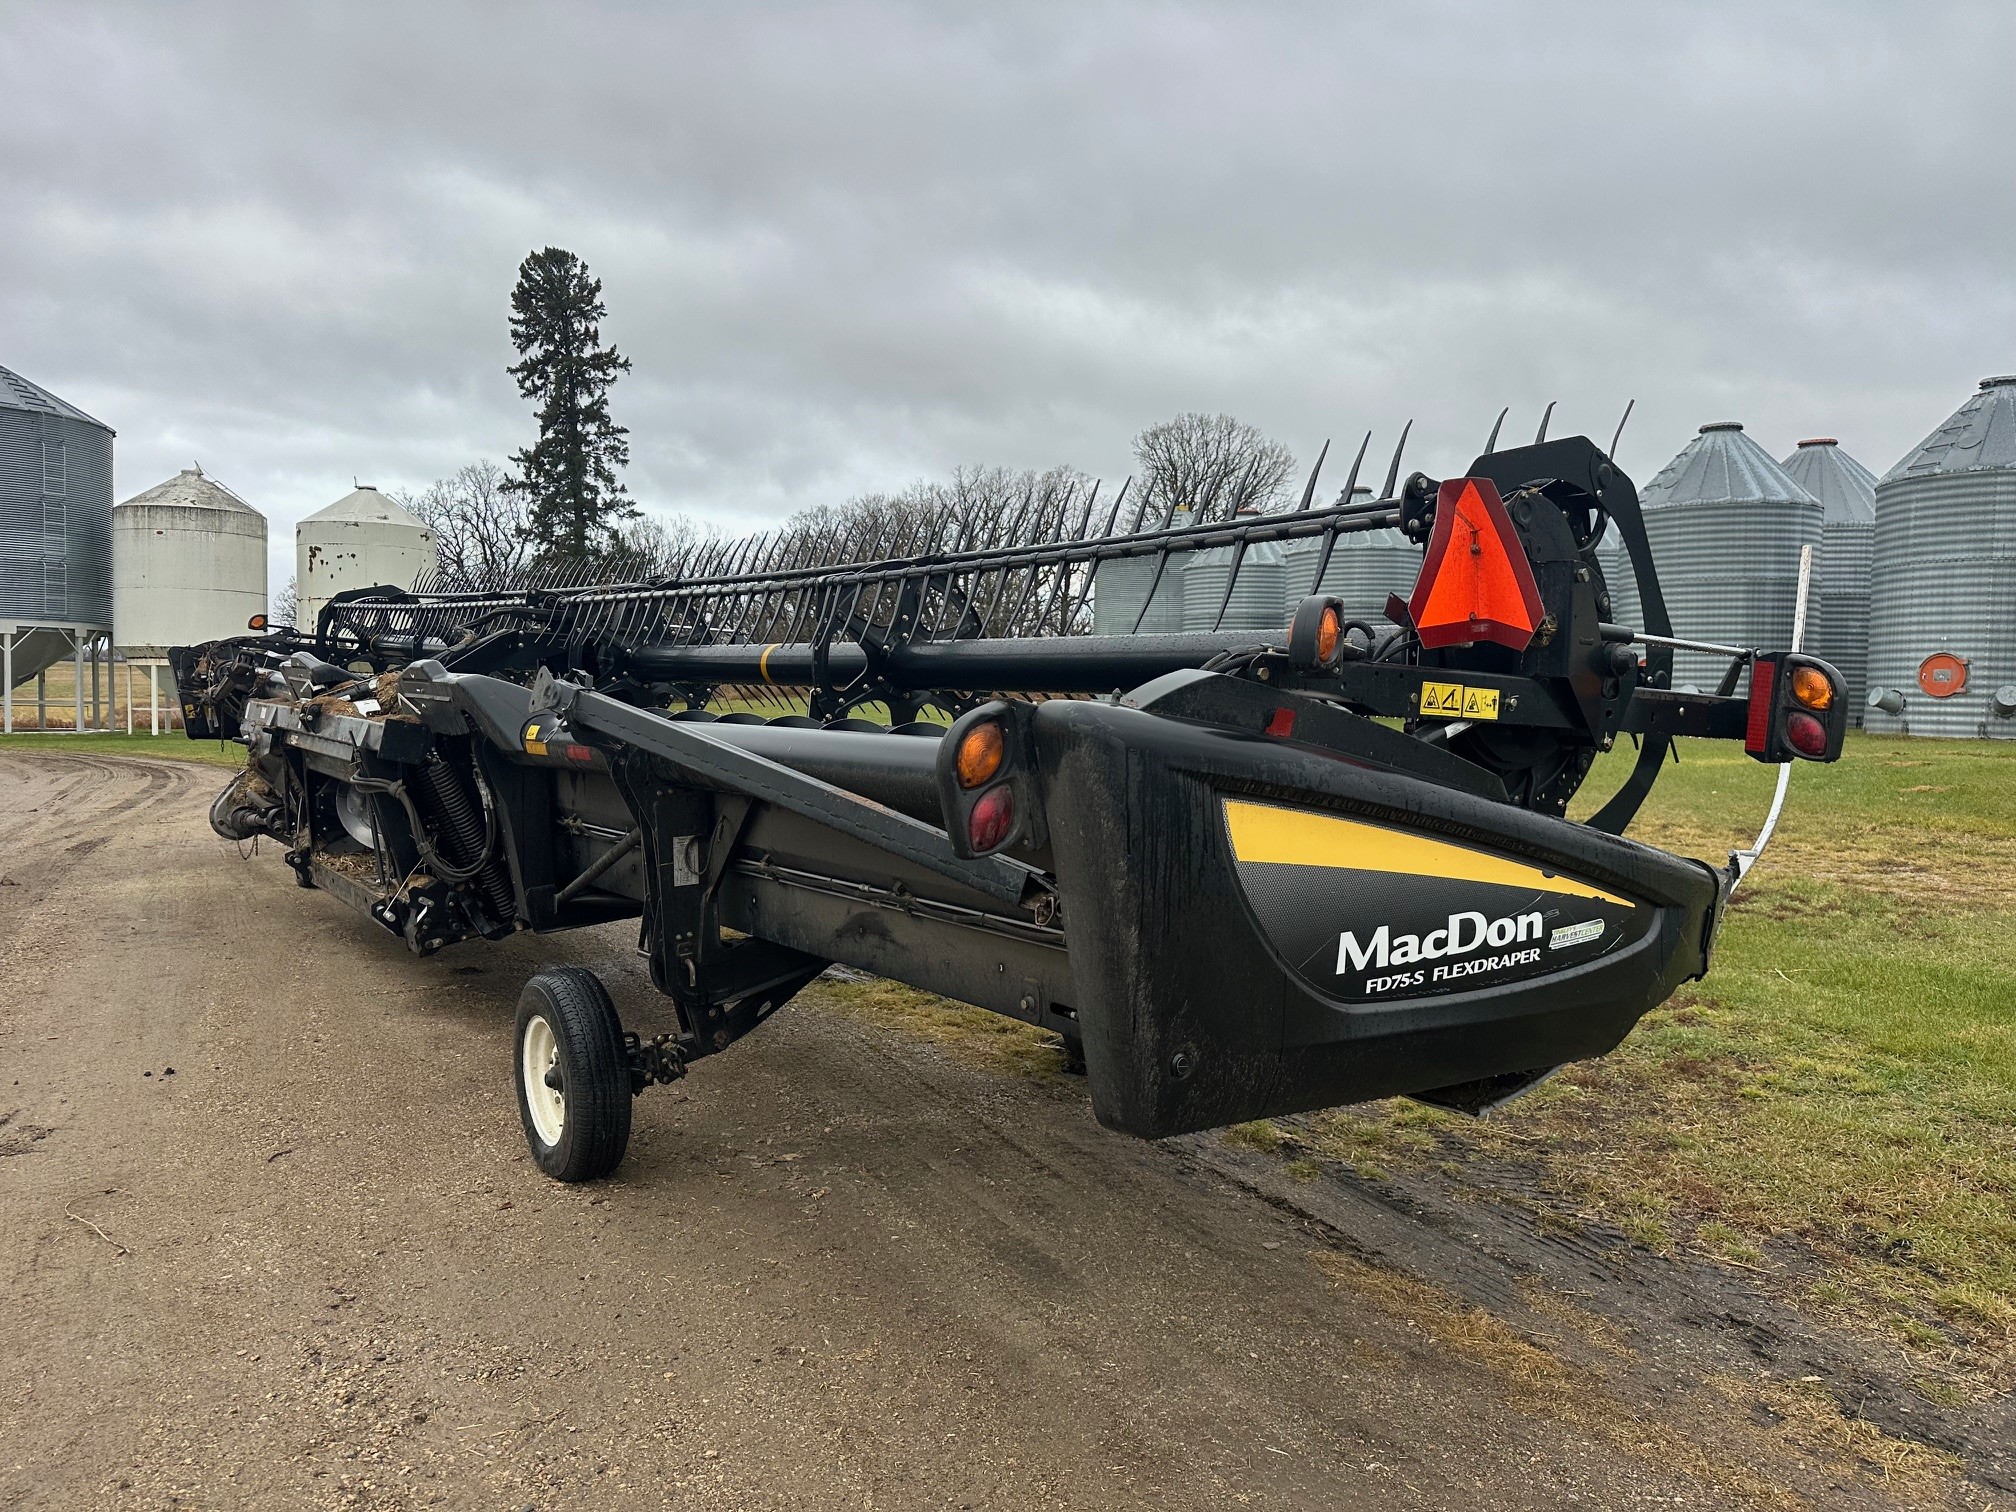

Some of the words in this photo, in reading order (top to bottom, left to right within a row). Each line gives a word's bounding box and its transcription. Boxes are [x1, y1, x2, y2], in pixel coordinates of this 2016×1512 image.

[1335, 910, 1543, 975] MacDon
[1365, 970, 1425, 994] FD75-S
[1432, 948, 1541, 982] FLEXDRAPER
